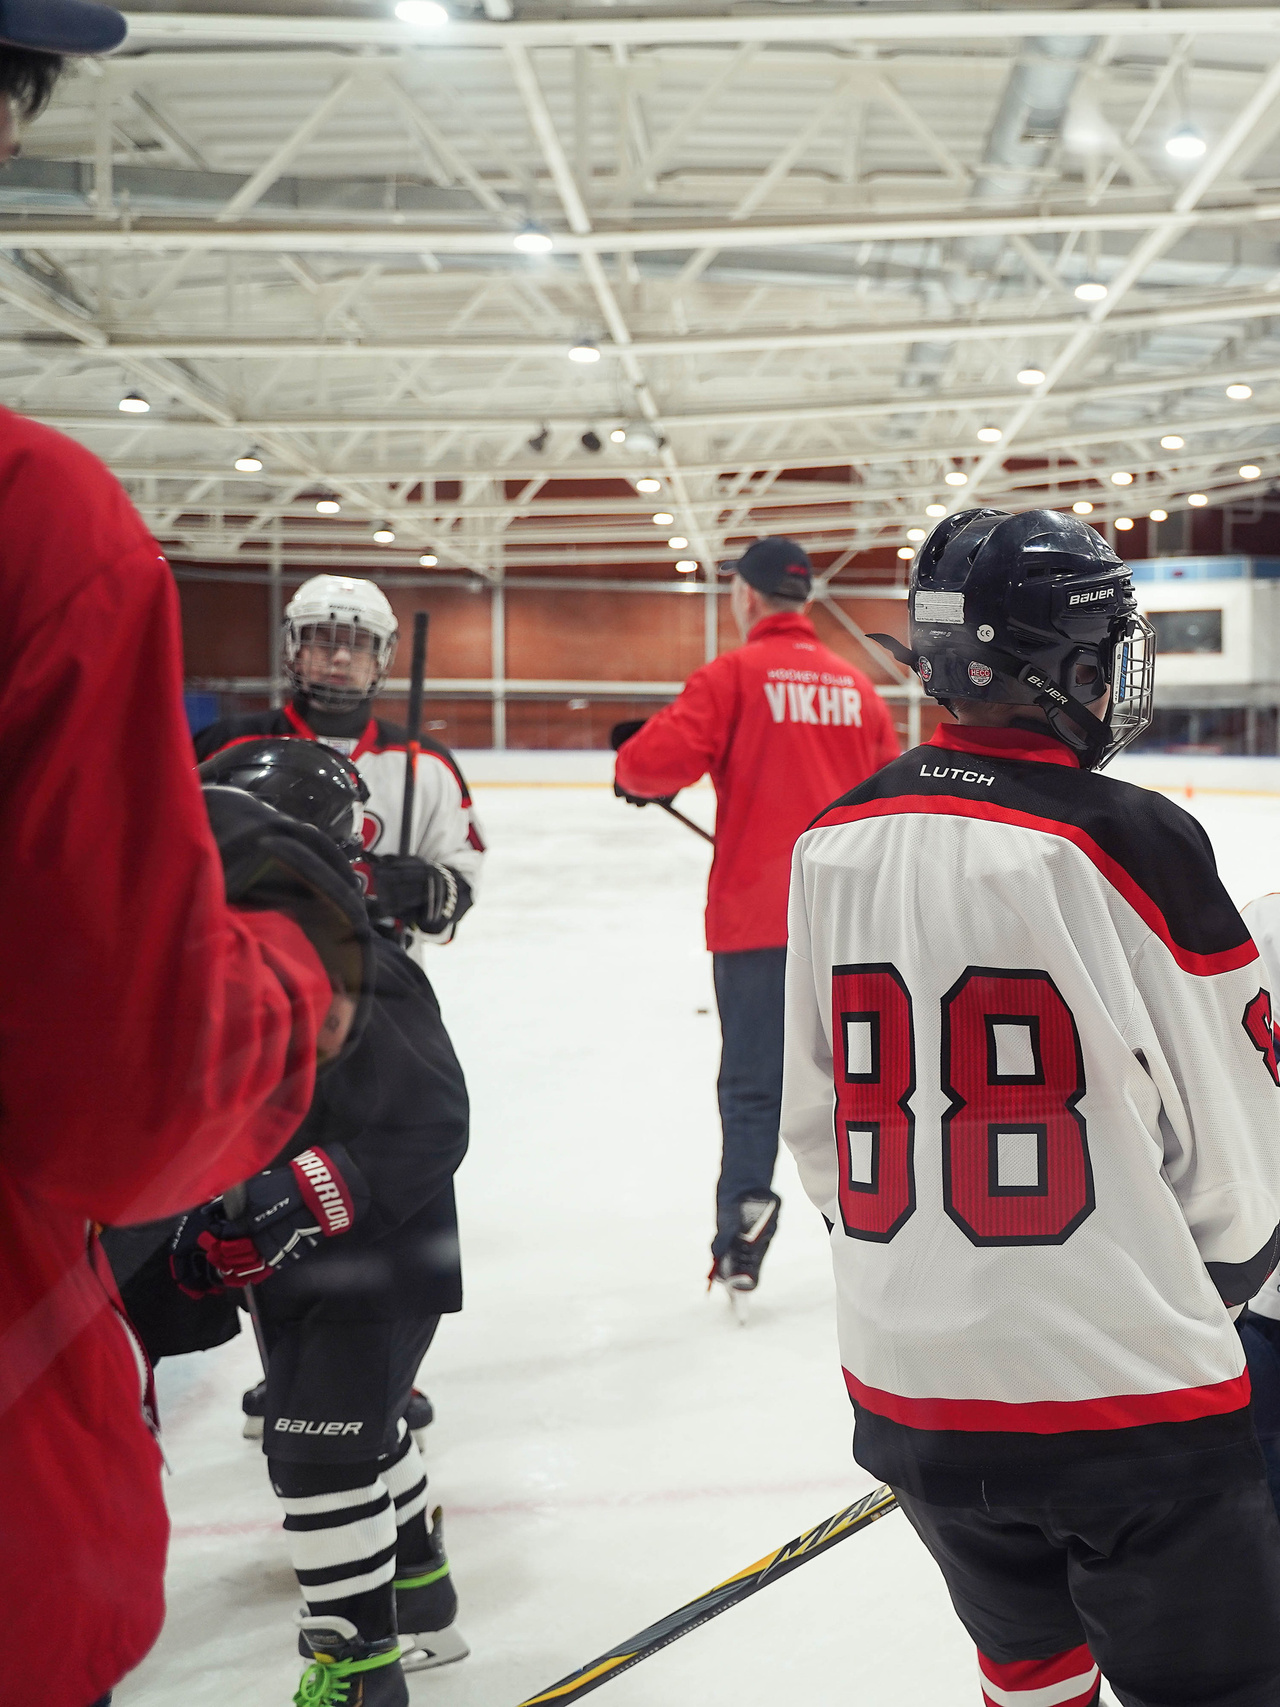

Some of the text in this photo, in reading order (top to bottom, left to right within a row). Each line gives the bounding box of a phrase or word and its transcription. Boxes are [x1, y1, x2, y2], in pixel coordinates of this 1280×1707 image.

[1069, 587, 1115, 606] BAUER
[767, 668, 855, 688] HOCKEY CLUB
[763, 681, 863, 728] VIKHR
[920, 764, 996, 787] LUTCH
[832, 962, 1096, 1248] 88
[274, 1417, 364, 1436] BAUER
